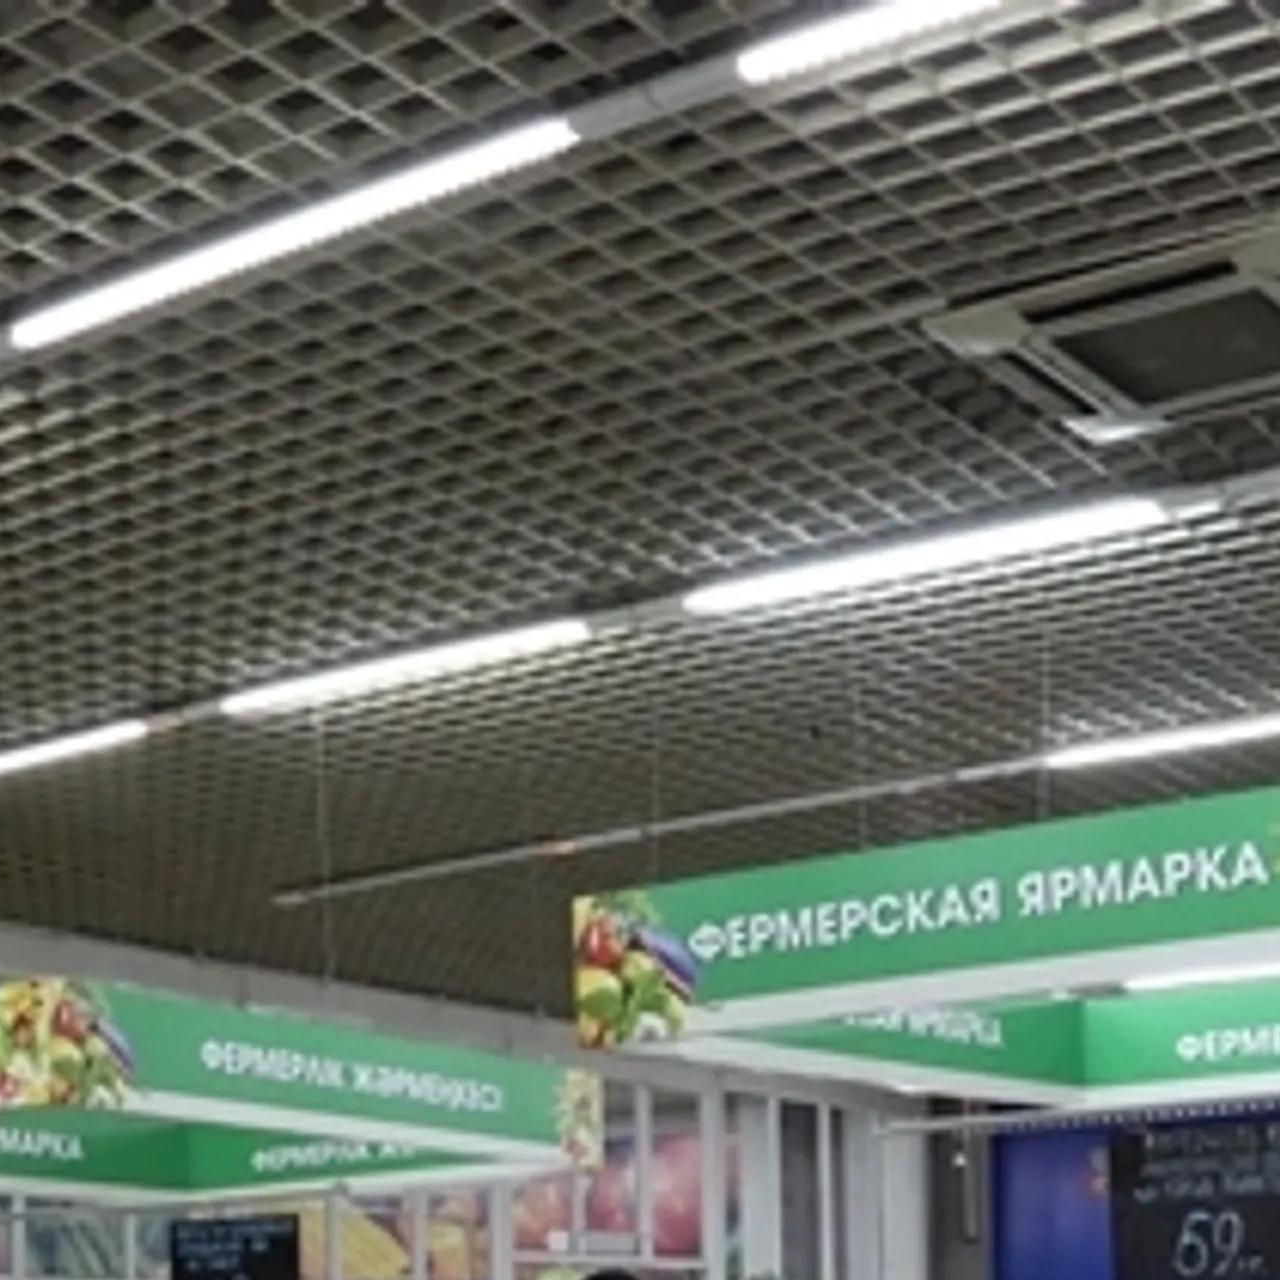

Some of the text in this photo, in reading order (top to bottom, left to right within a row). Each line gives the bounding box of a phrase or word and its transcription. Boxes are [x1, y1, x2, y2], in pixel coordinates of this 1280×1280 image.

[687, 840, 1269, 962] ФЕРМЕРСКАЯ ЯРМАРКА
[1174, 1207, 1246, 1278] 69
